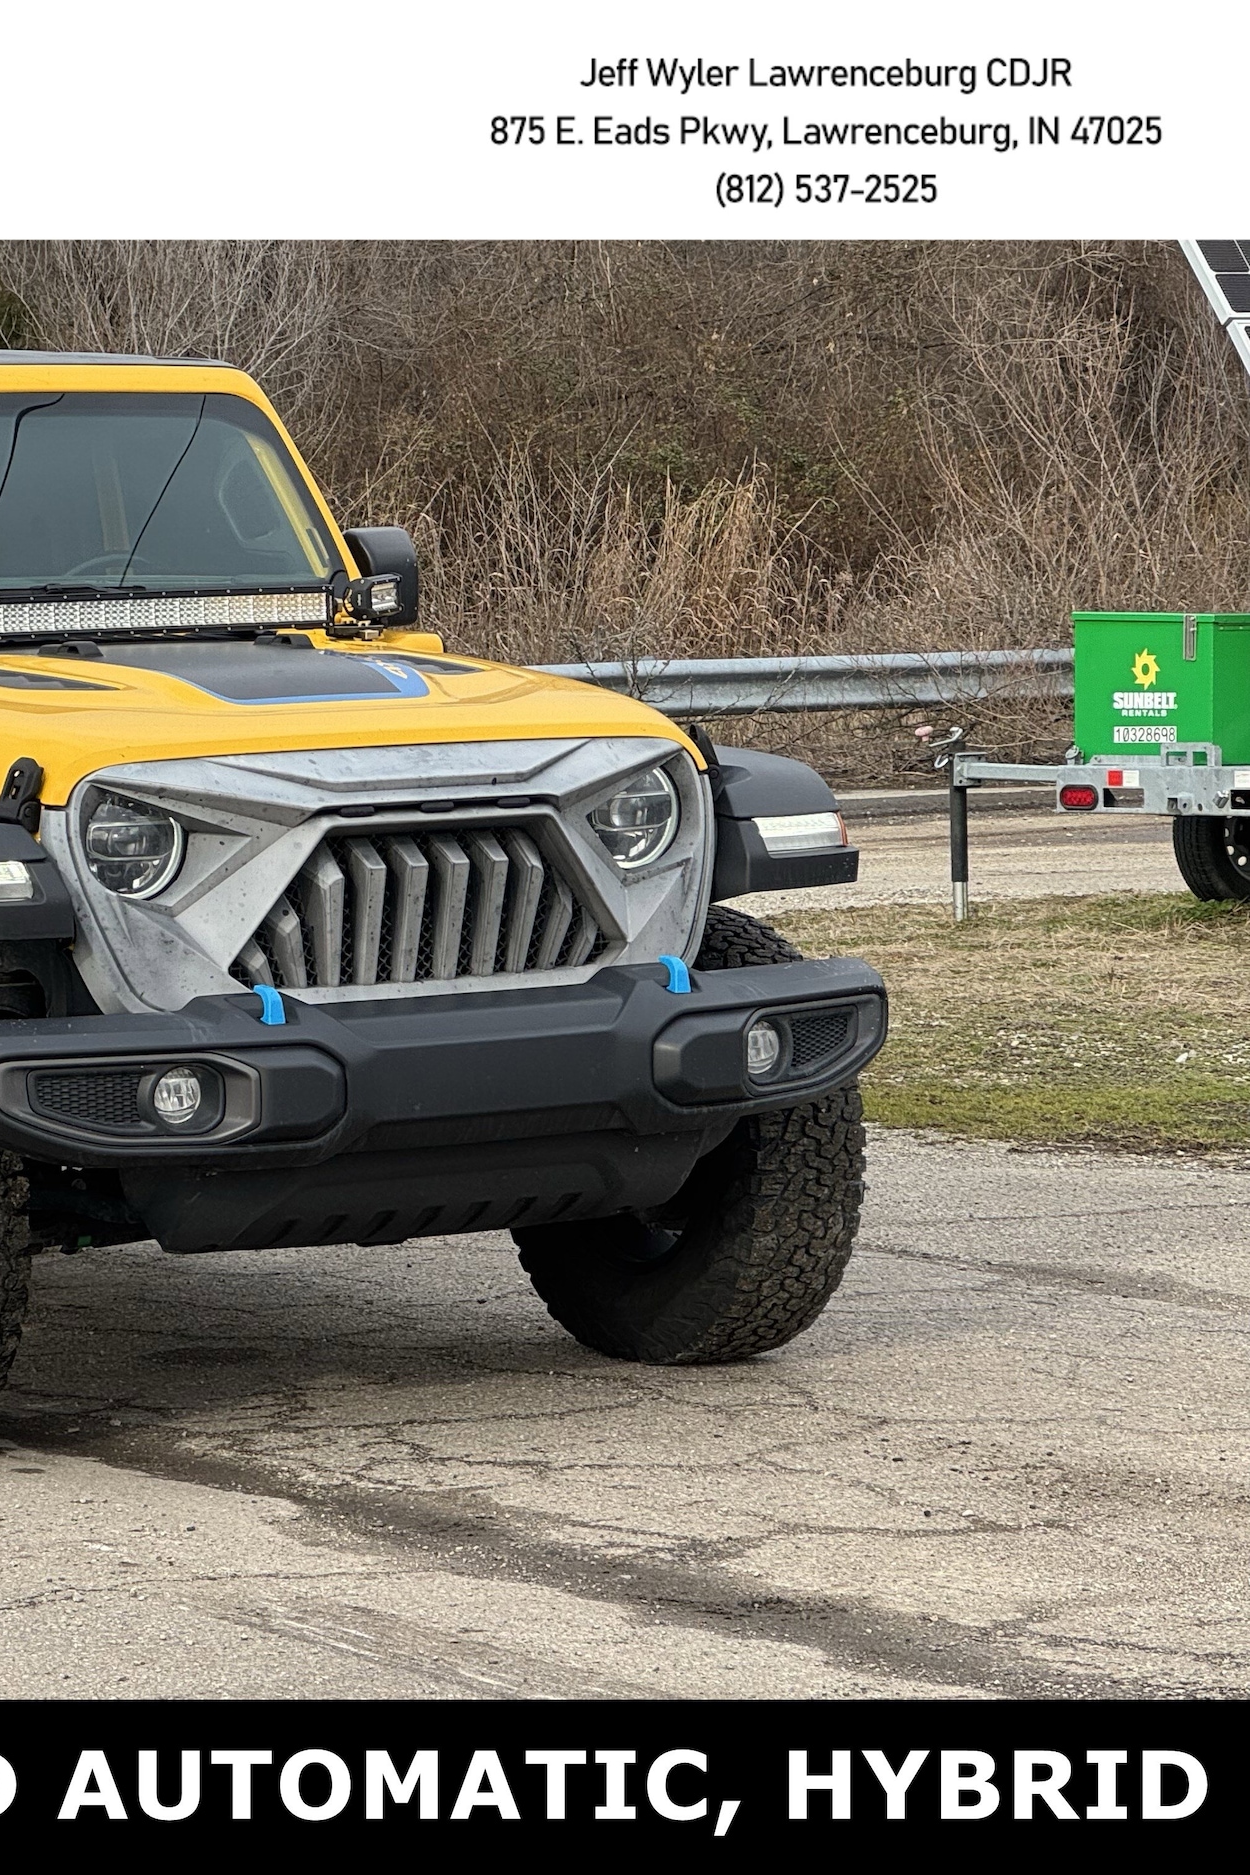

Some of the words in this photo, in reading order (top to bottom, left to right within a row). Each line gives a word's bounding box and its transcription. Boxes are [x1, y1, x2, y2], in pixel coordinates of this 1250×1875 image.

[1113, 692, 1177, 709] SUNBELT
[1121, 709, 1167, 717] RENTALS
[1115, 727, 1176, 742] 10328698
